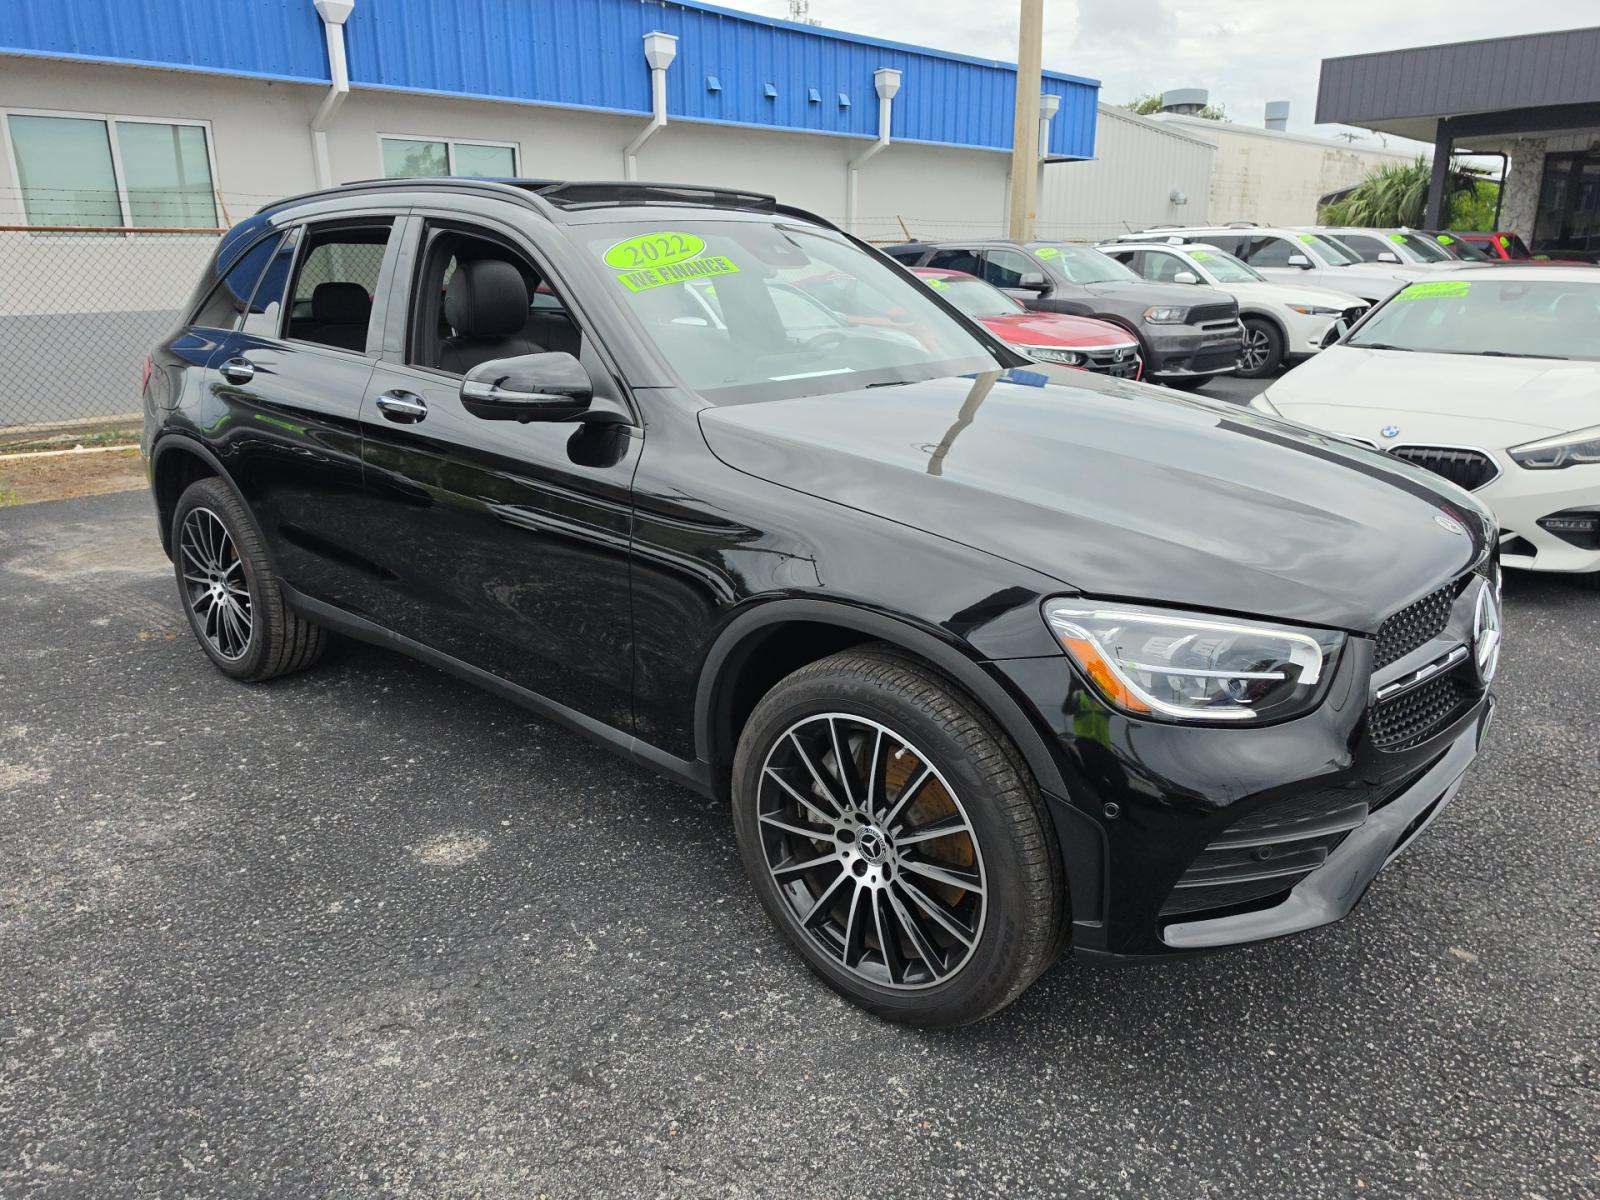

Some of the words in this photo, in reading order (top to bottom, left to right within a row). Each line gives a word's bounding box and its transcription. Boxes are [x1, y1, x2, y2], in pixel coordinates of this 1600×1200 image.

[624, 235, 690, 266] 2022
[626, 269, 660, 288] WE
[658, 258, 730, 281] FINANCE
